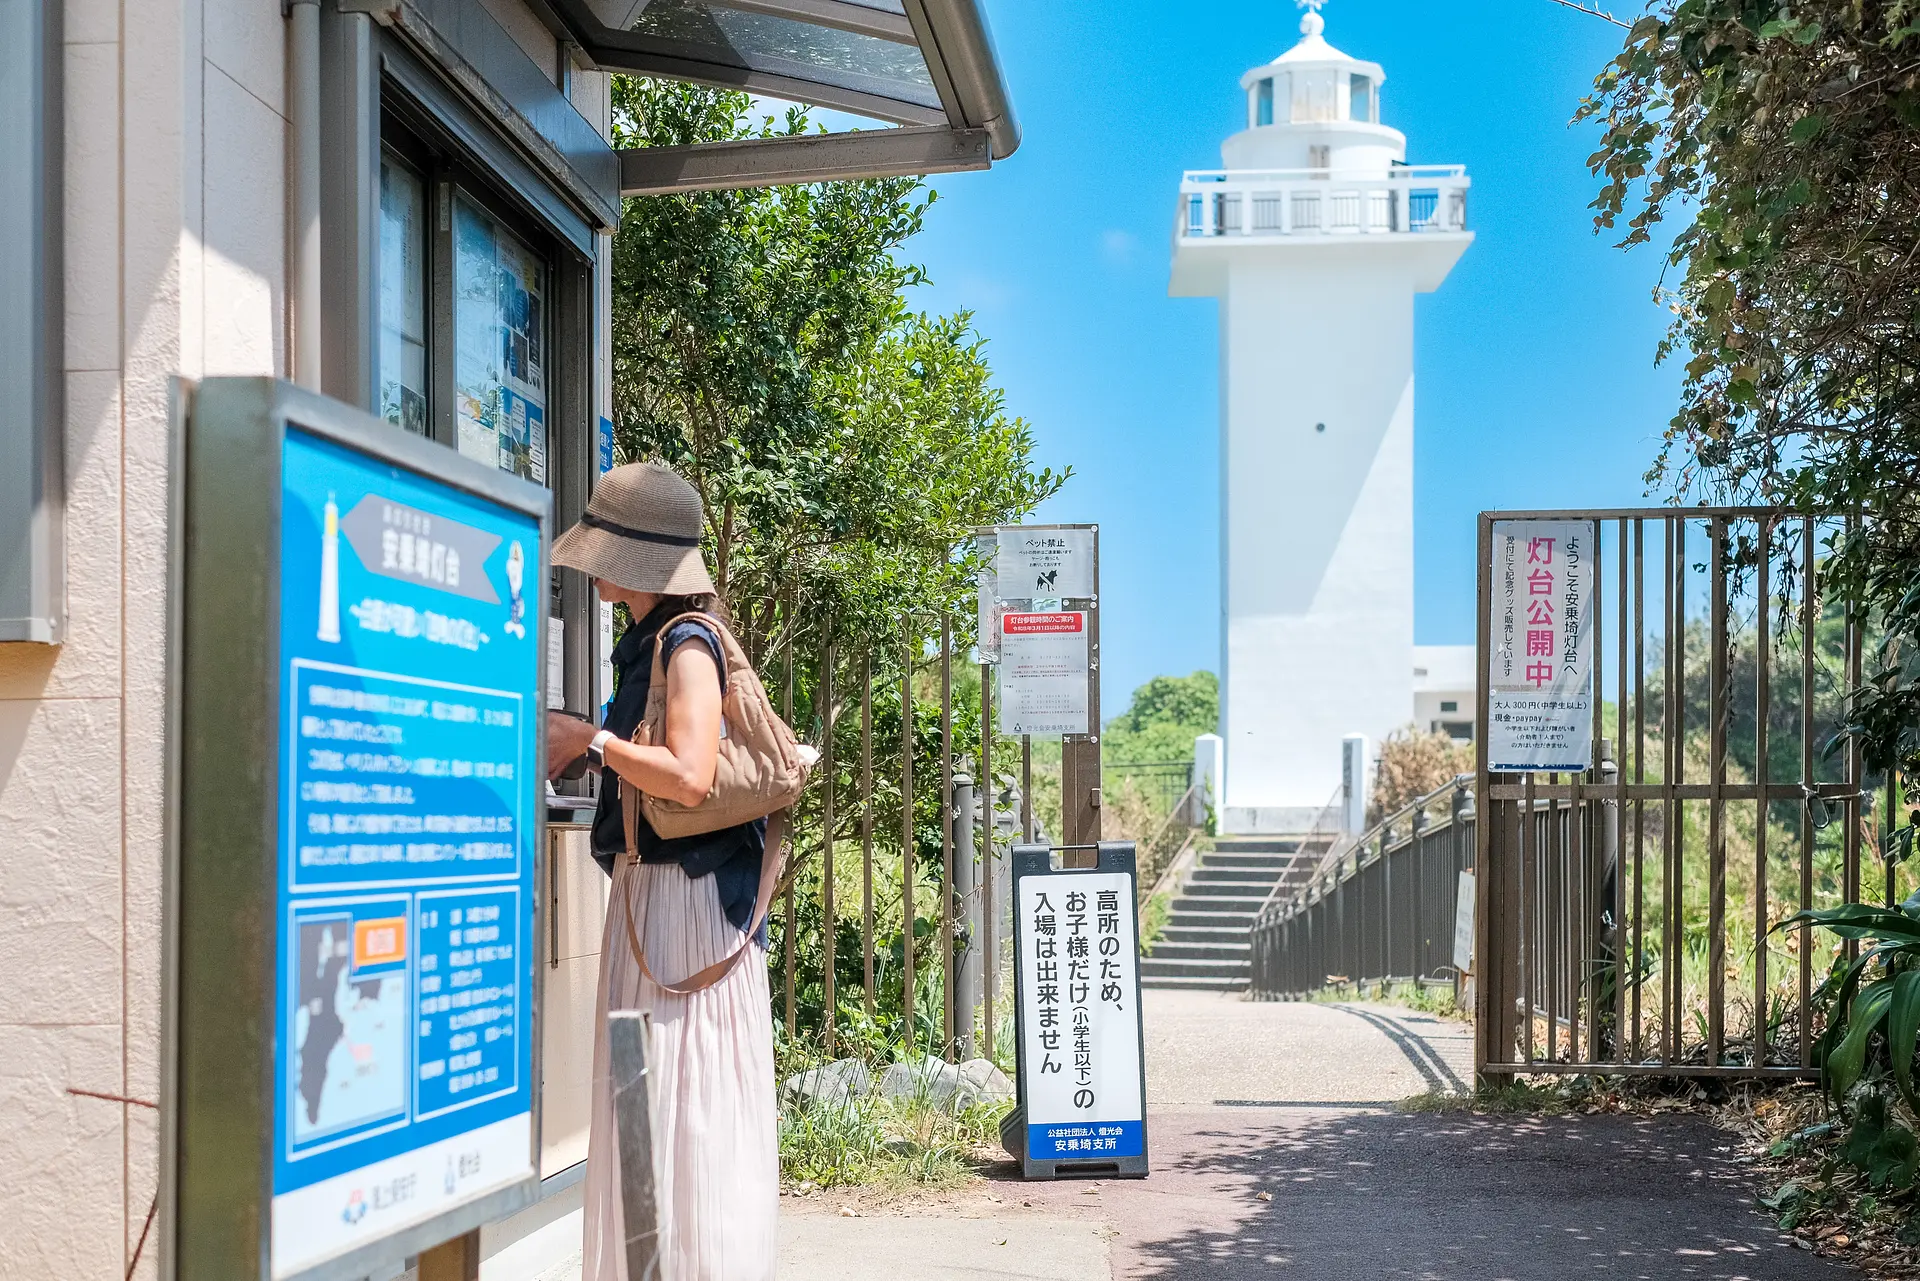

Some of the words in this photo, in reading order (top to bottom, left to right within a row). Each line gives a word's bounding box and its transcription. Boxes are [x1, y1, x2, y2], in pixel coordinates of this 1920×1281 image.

[1026, 539, 1065, 547] ペット禁止
[1504, 536, 1515, 676] 受付にて記念グッズ販売しています
[1564, 536, 1579, 675] ようこそ安乗埼灯台へ
[1526, 536, 1556, 688] 灯台公開中
[1033, 892, 1061, 1074] 入場は出来ません
[1096, 889, 1123, 1013] 高所のため、
[1048, 1128, 1096, 1137] 公益社団法人
[1055, 1138, 1116, 1151] 安乗埼支所
